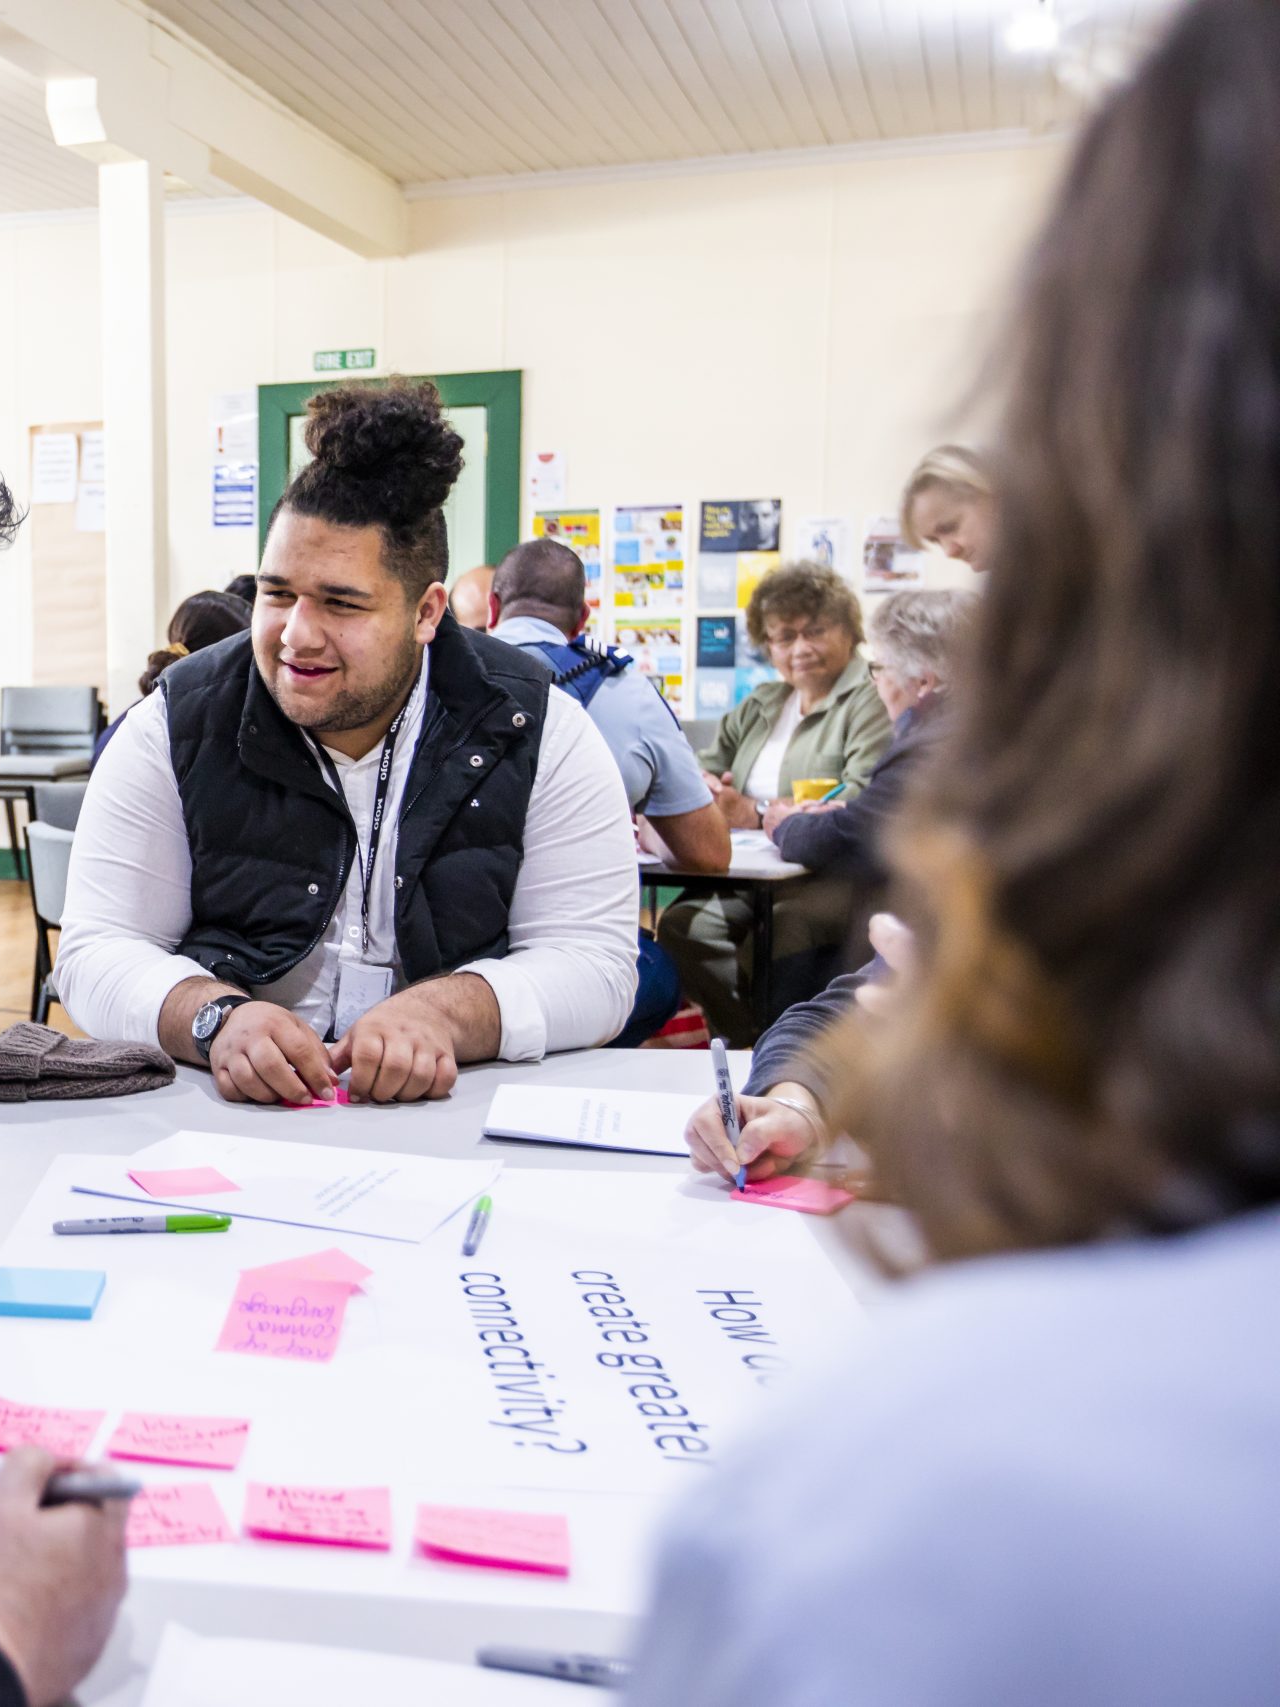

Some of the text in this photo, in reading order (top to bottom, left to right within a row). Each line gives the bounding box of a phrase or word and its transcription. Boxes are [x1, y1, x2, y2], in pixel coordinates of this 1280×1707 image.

[346, 351, 372, 368] EXIT
[380, 749, 391, 781] MOJO
[373, 798, 383, 831] MOJO
[570, 1270, 651, 1344] create
[695, 1290, 779, 1346] How
[458, 1272, 588, 1454] connectivity?
